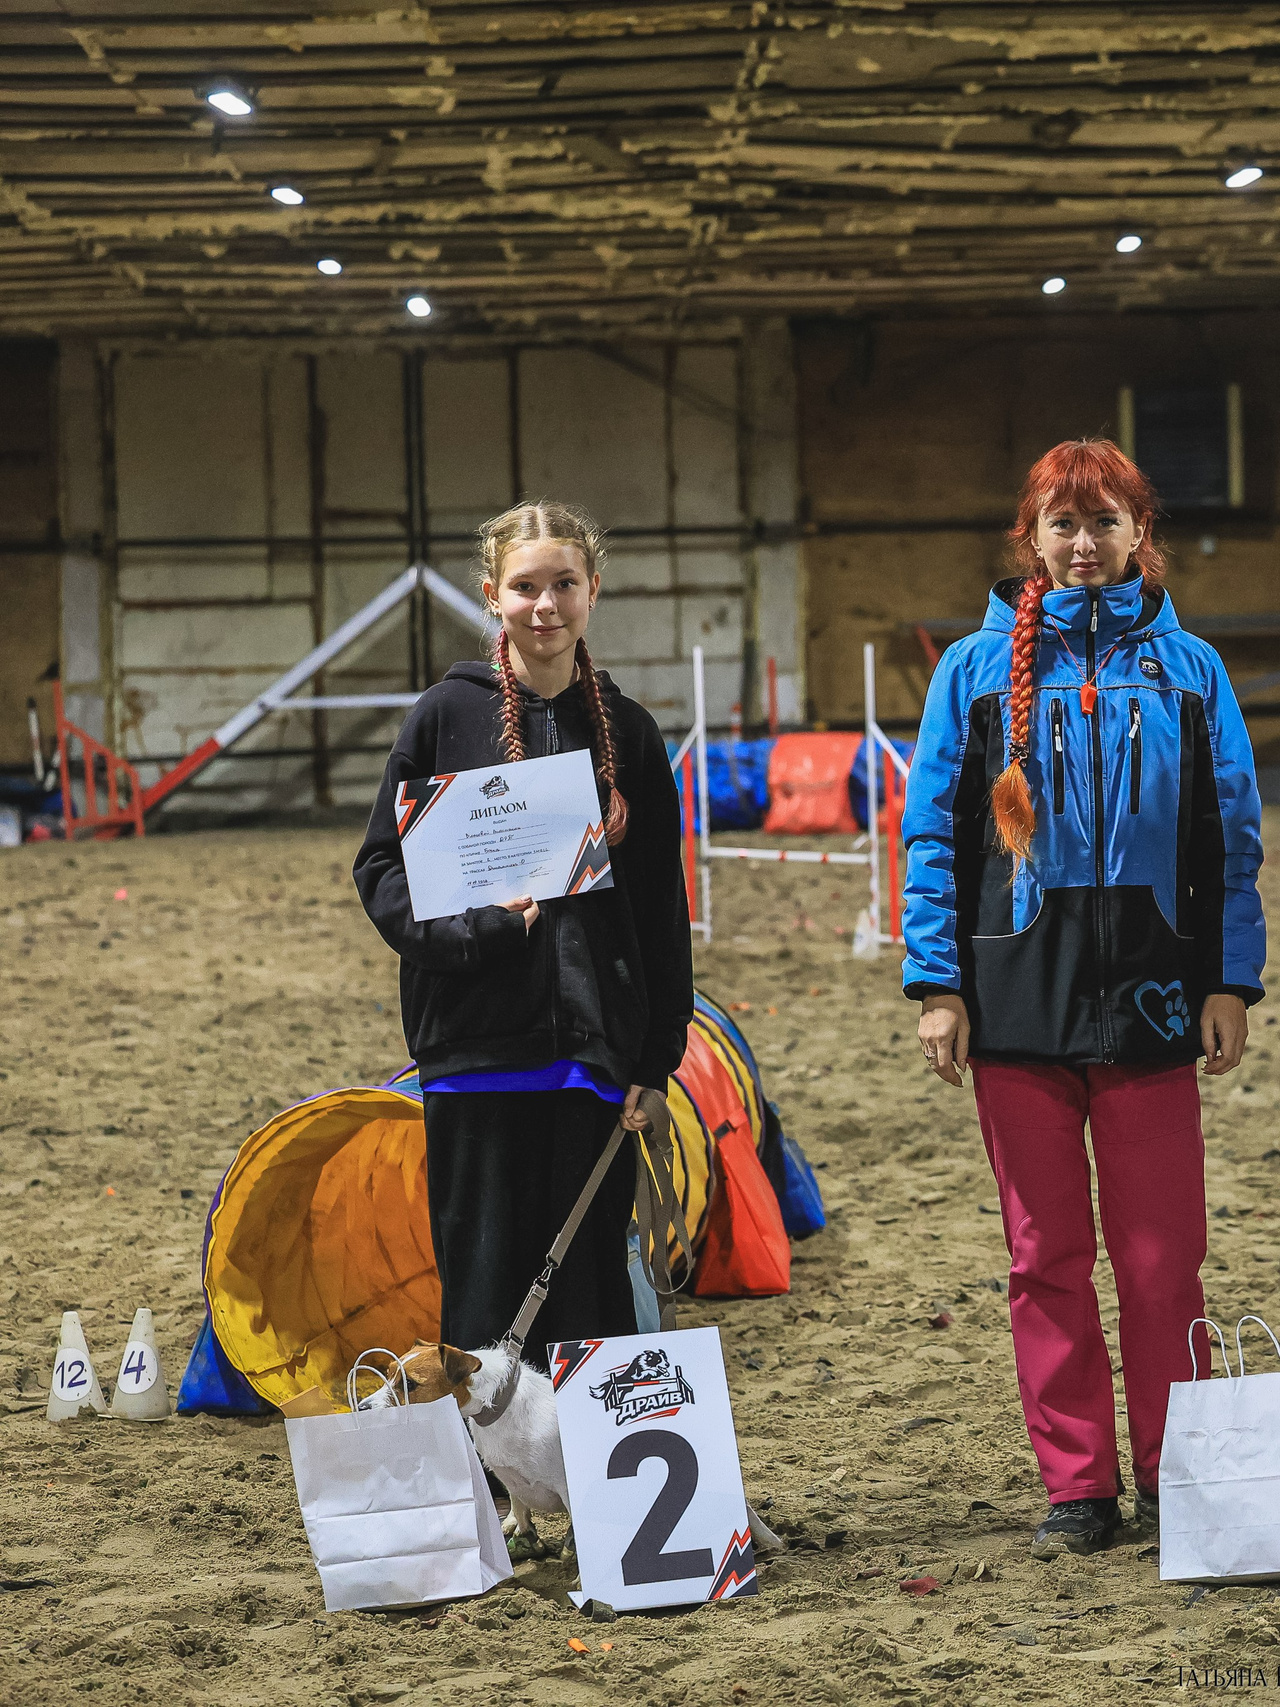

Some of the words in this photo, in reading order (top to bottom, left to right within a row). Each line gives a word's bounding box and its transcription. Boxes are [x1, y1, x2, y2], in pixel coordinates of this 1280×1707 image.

[469, 800, 528, 821] ДИПЛОМ
[56, 1360, 88, 1389] 12
[123, 1350, 147, 1385] 4
[616, 1388, 685, 1426] ДРАЙВ
[607, 1429, 715, 1586] 2
